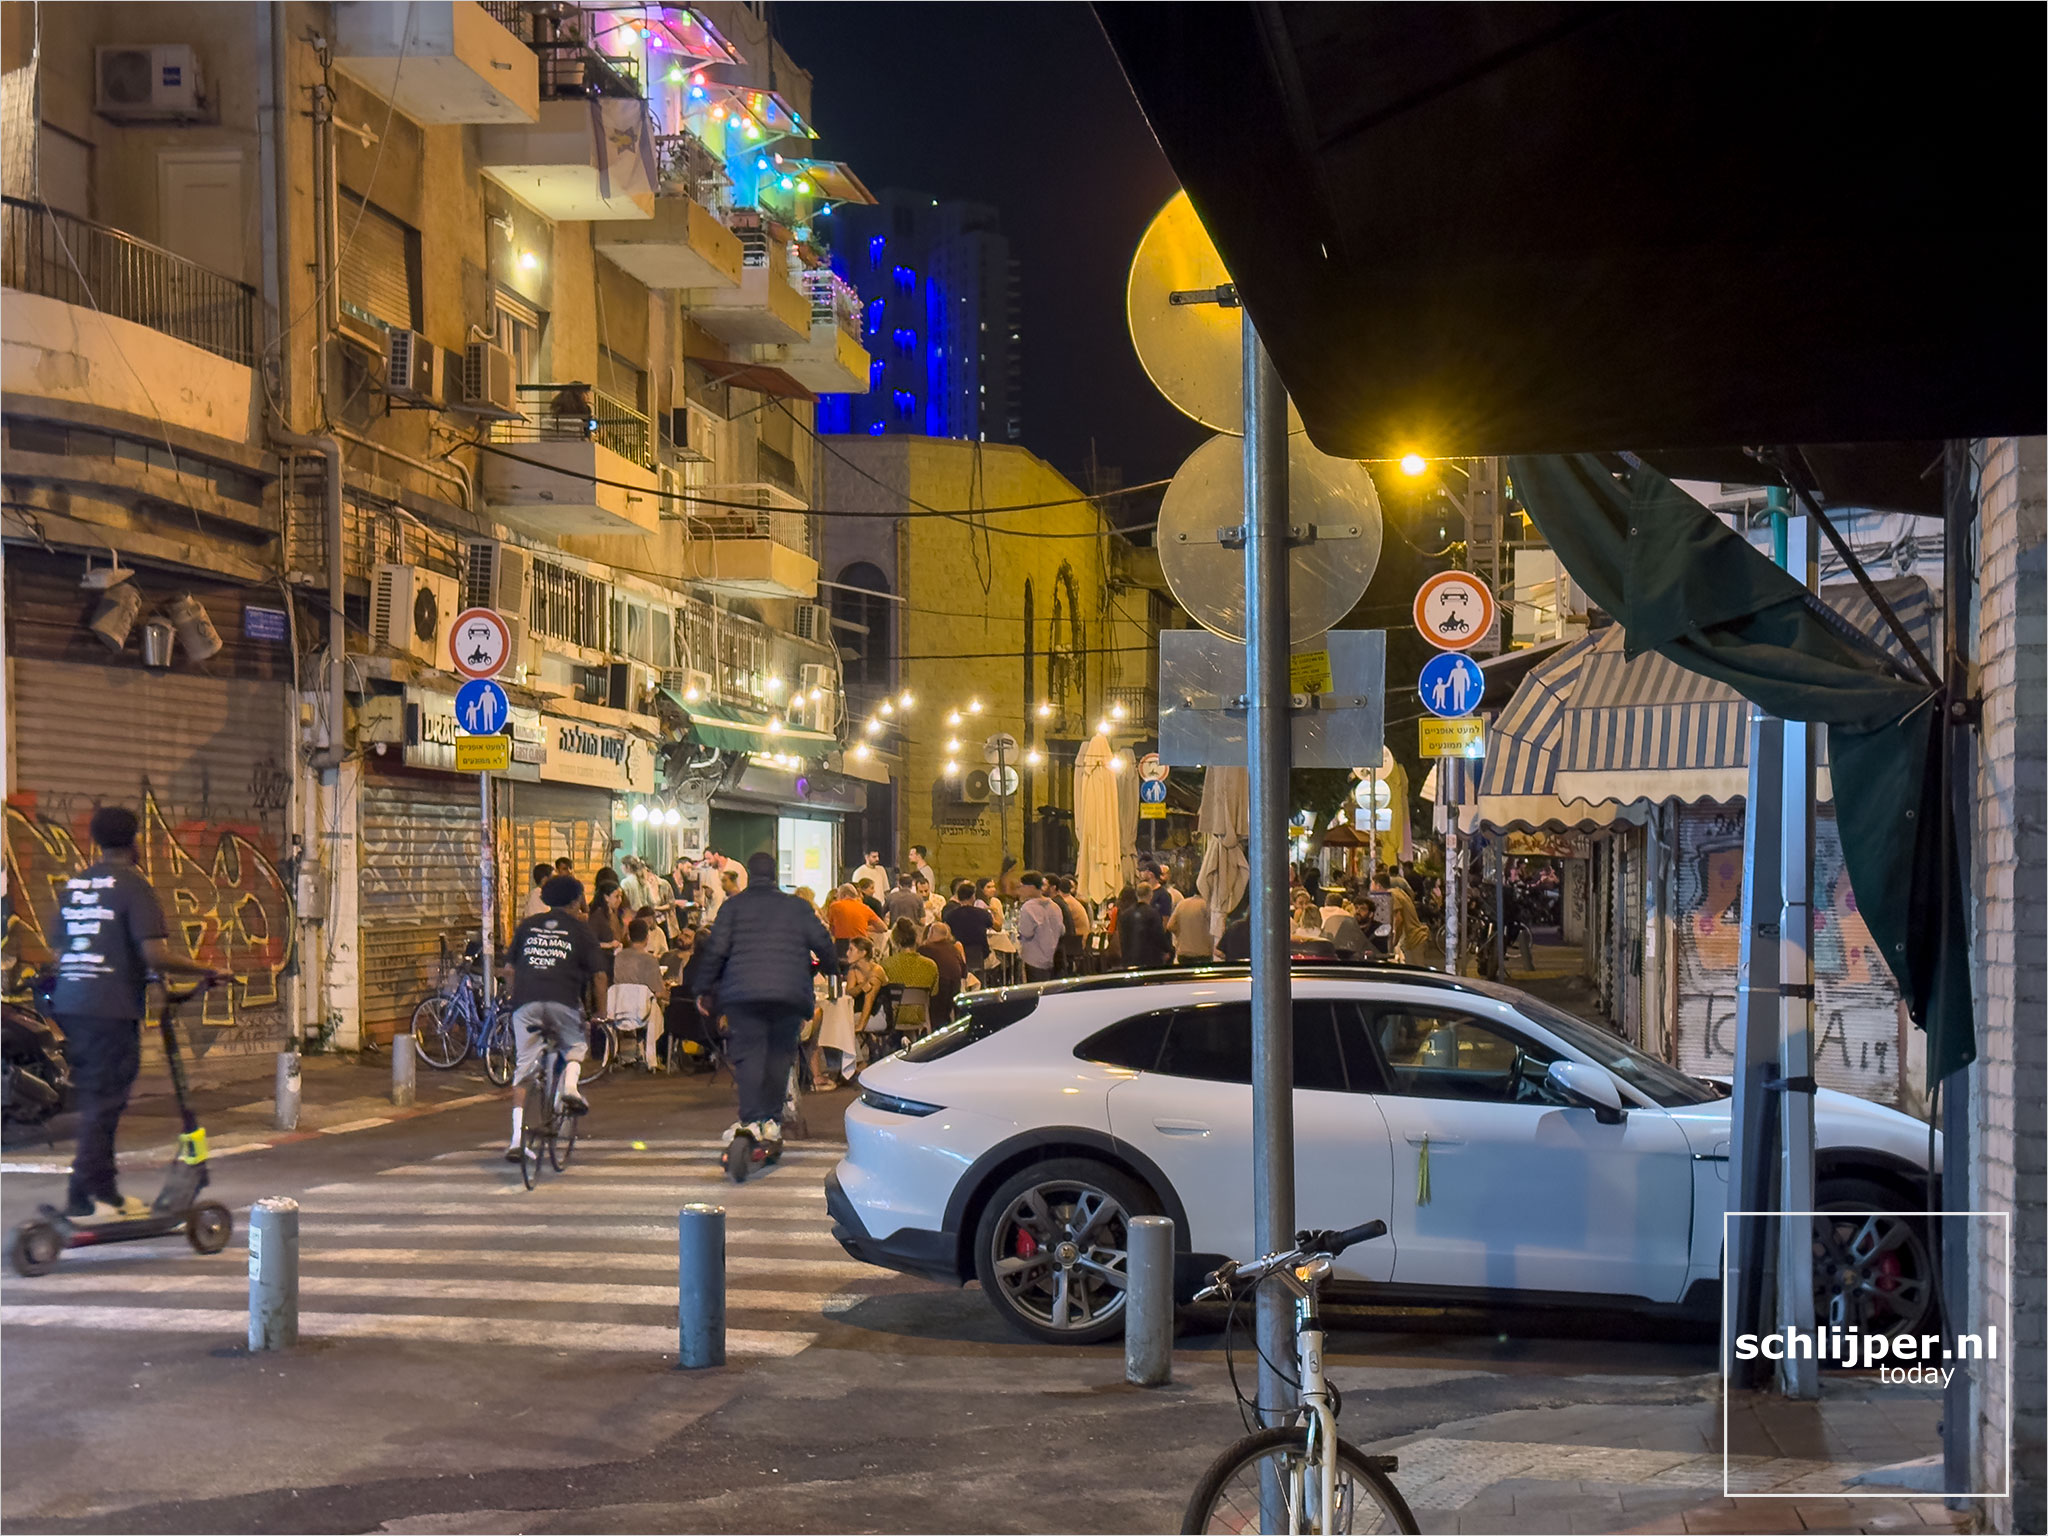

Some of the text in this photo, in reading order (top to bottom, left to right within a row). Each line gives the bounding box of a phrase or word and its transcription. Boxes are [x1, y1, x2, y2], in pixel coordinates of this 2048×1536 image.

[1424, 725, 1480, 735] למעט אופניים
[485, 742, 506, 751] למעט
[493, 756, 502, 765] לא
[549, 939, 572, 951] MAYA
[523, 947, 567, 959] SUNDOWN
[528, 956, 556, 966] SCENE
